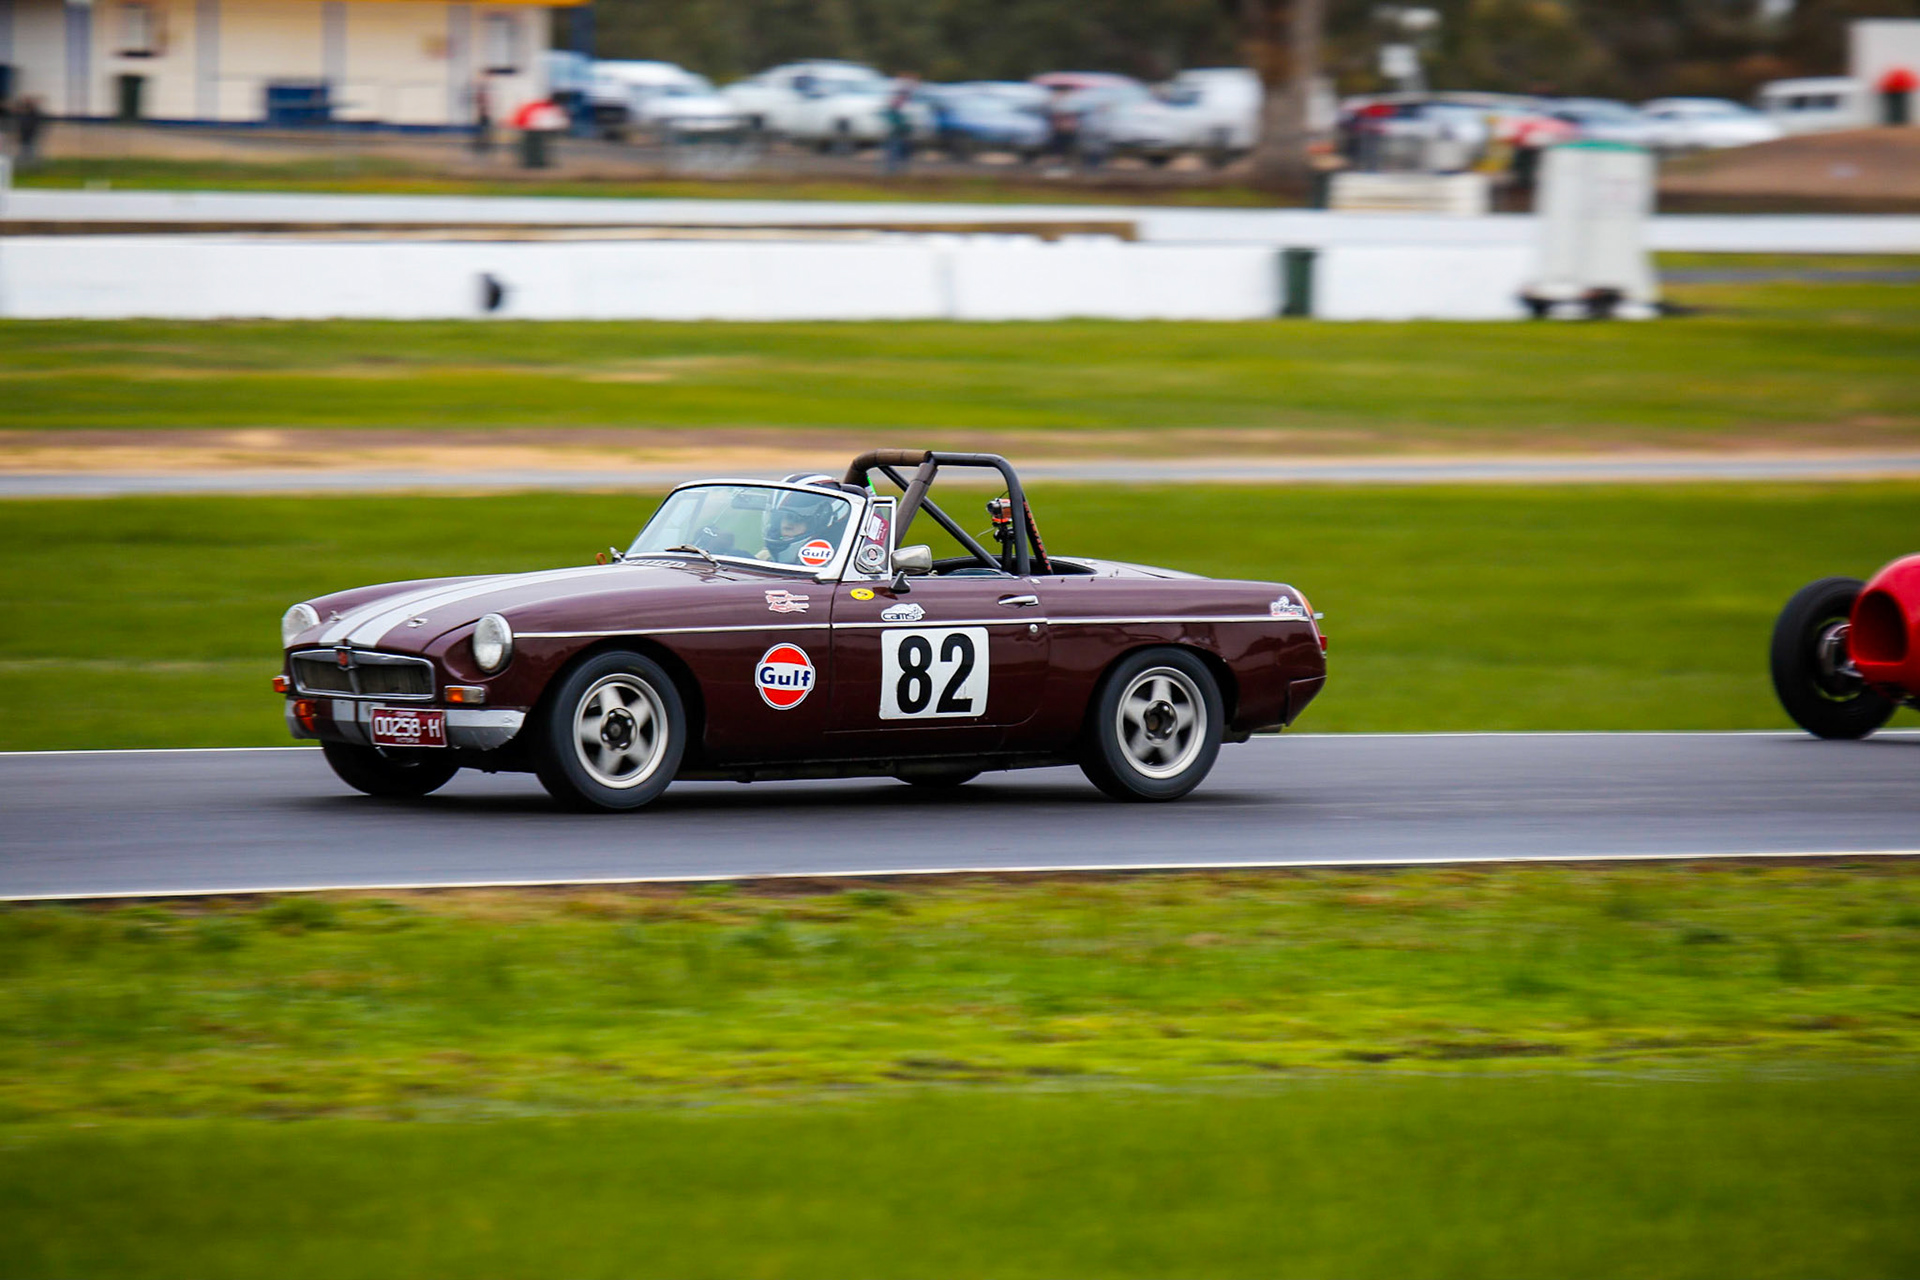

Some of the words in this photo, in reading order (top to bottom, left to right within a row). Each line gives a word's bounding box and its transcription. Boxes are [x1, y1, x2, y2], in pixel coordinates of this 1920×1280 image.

[801, 548, 831, 558] Gulf
[760, 666, 811, 687] Gulf
[897, 633, 975, 714] 82
